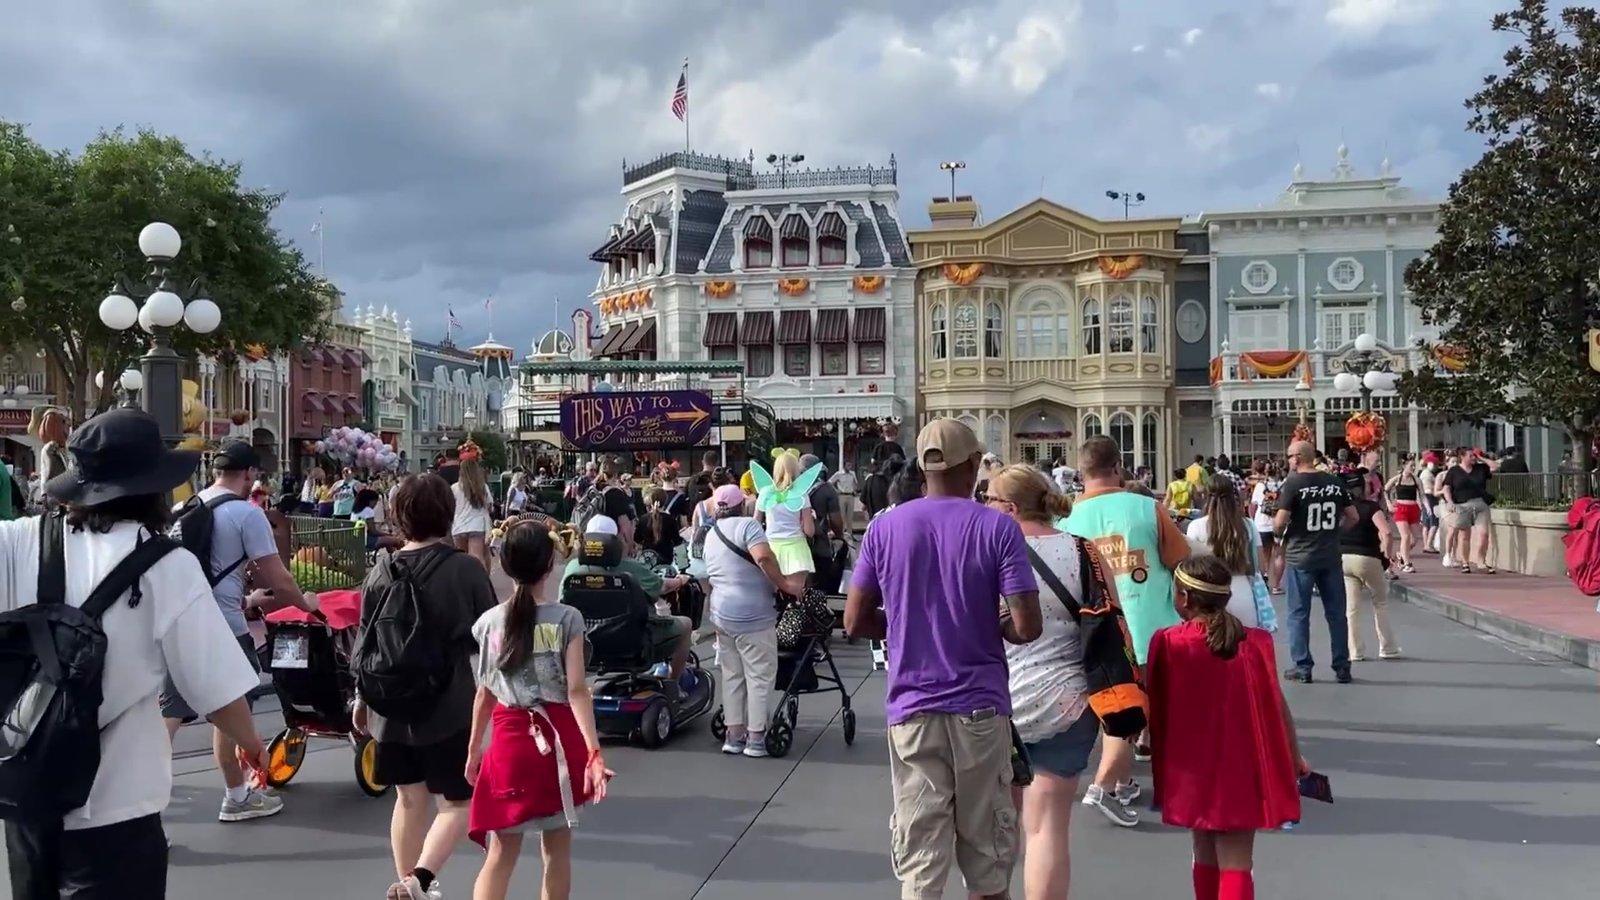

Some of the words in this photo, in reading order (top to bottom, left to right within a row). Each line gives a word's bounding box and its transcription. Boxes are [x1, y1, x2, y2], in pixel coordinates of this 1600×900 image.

[572, 398, 604, 440] THIS
[608, 396, 645, 419] WAY
[1307, 501, 1336, 531] 03
[1098, 540, 1123, 555] TOW
[1106, 554, 1138, 570] TER
